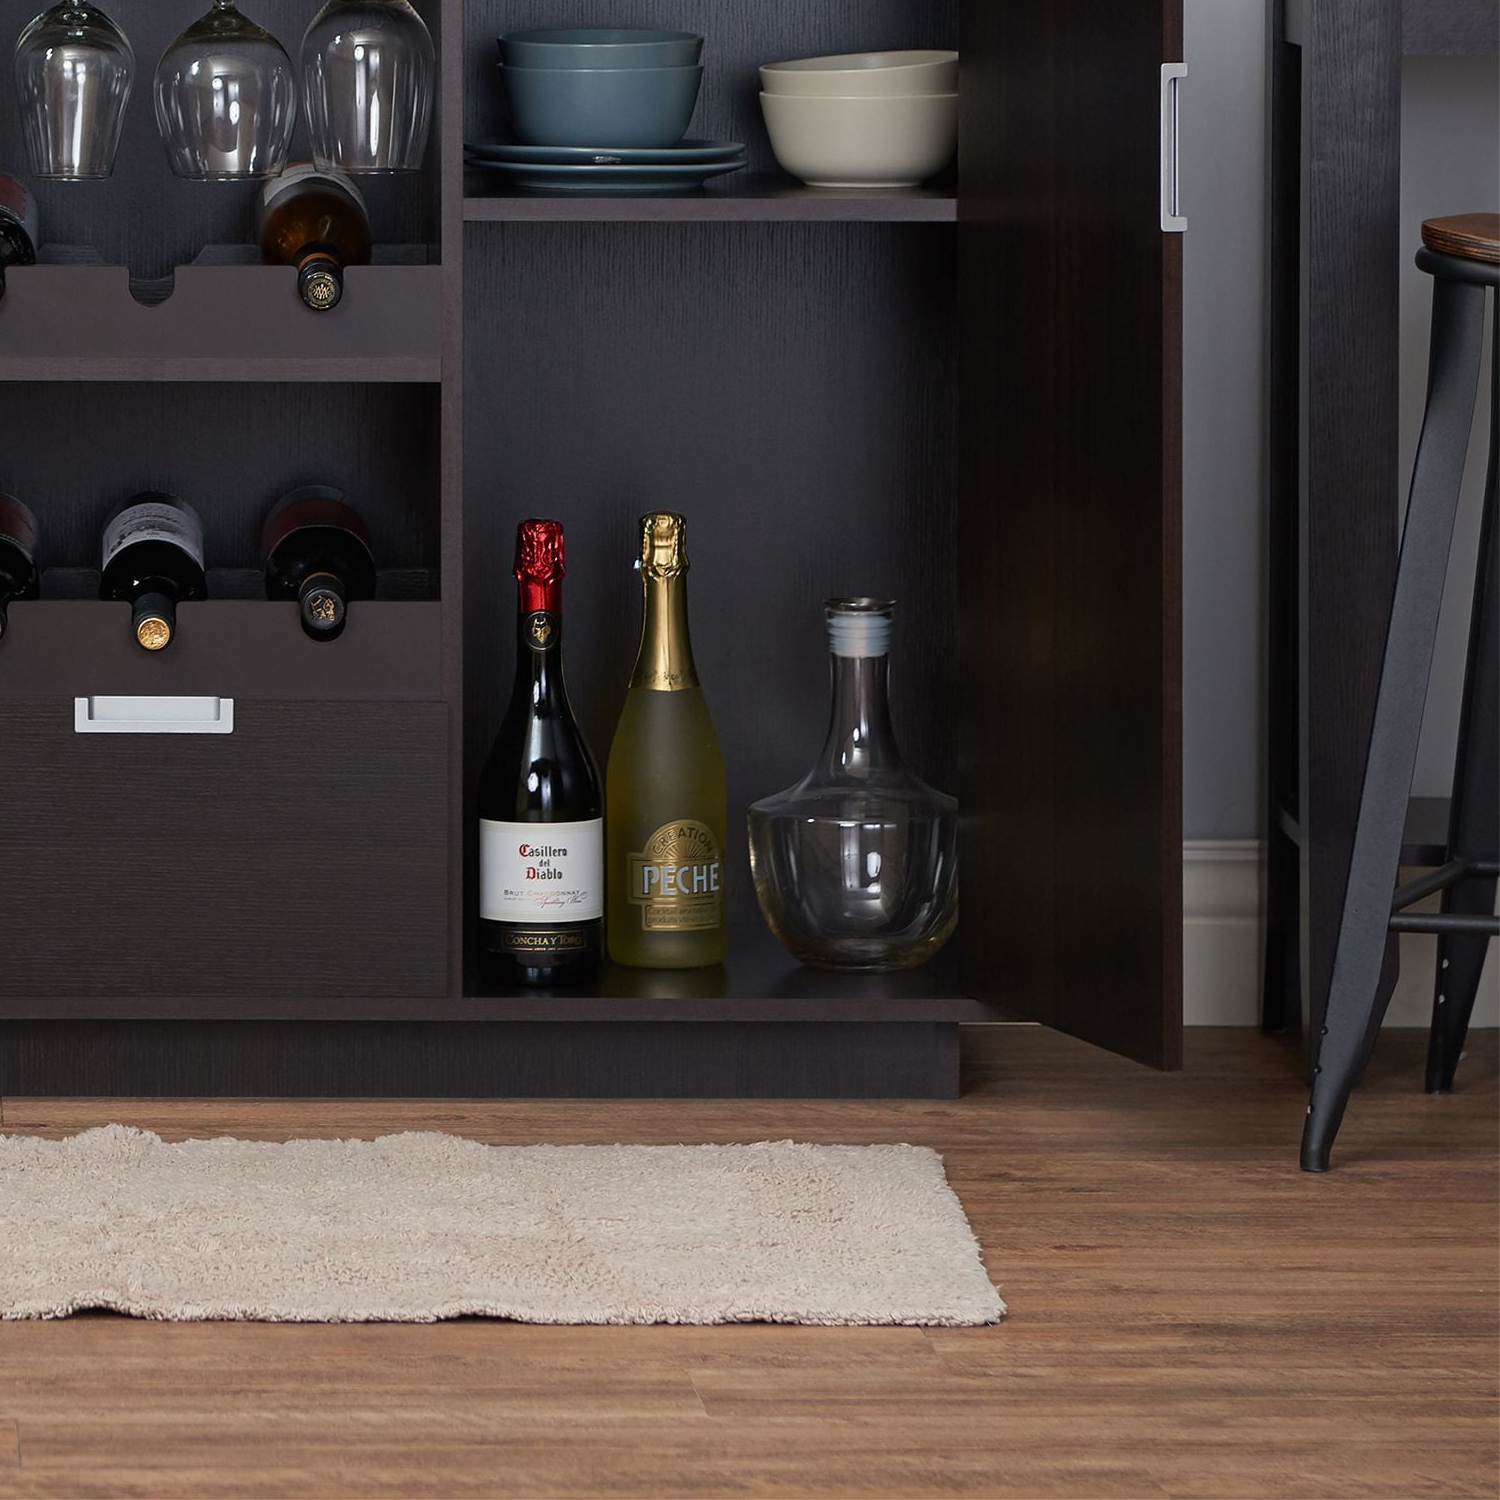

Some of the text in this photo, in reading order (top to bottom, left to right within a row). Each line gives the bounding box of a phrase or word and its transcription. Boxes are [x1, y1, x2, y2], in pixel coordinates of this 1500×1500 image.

[652, 827, 714, 855] CREATION
[519, 843, 568, 857] Casillero
[539, 859, 550, 867] del
[525, 867, 563, 880] Diablo
